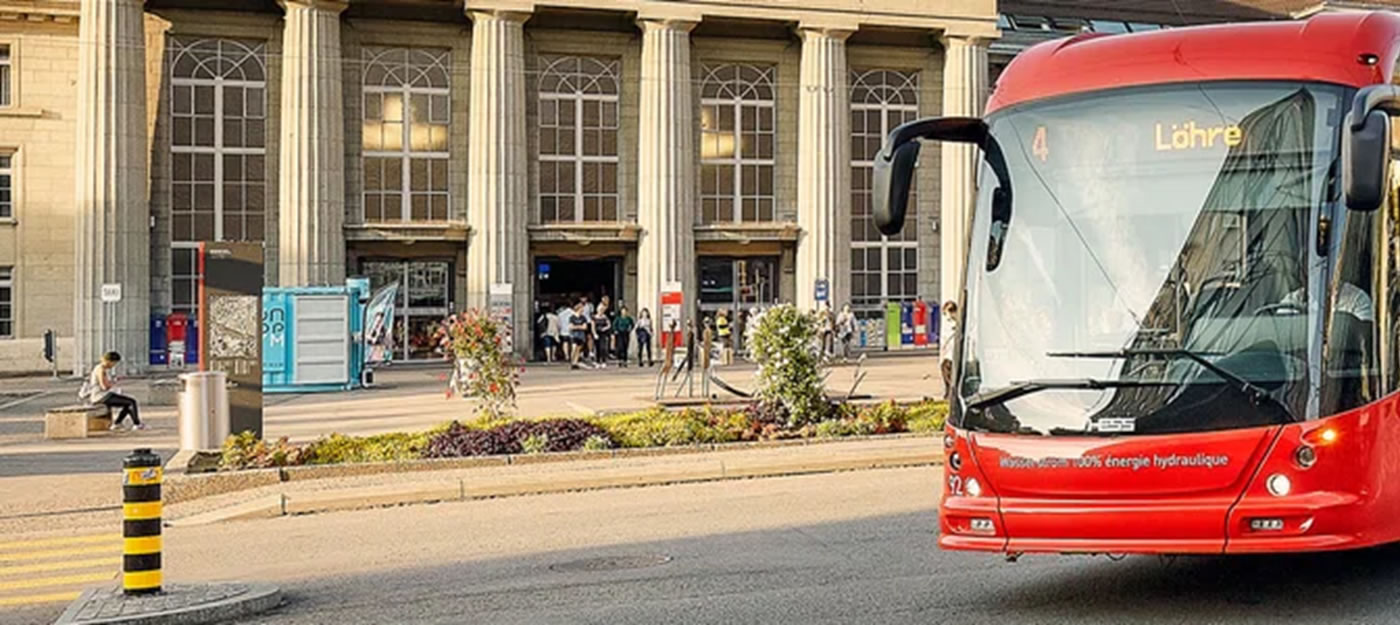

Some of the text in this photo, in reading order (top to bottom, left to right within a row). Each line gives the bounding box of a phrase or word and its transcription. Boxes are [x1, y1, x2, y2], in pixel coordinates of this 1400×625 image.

[1032, 126, 1049, 161] 4
[1154, 122, 1243, 151] Löhre
[1104, 454, 1150, 470] énergie
[1153, 453, 1228, 469] hydraulique
